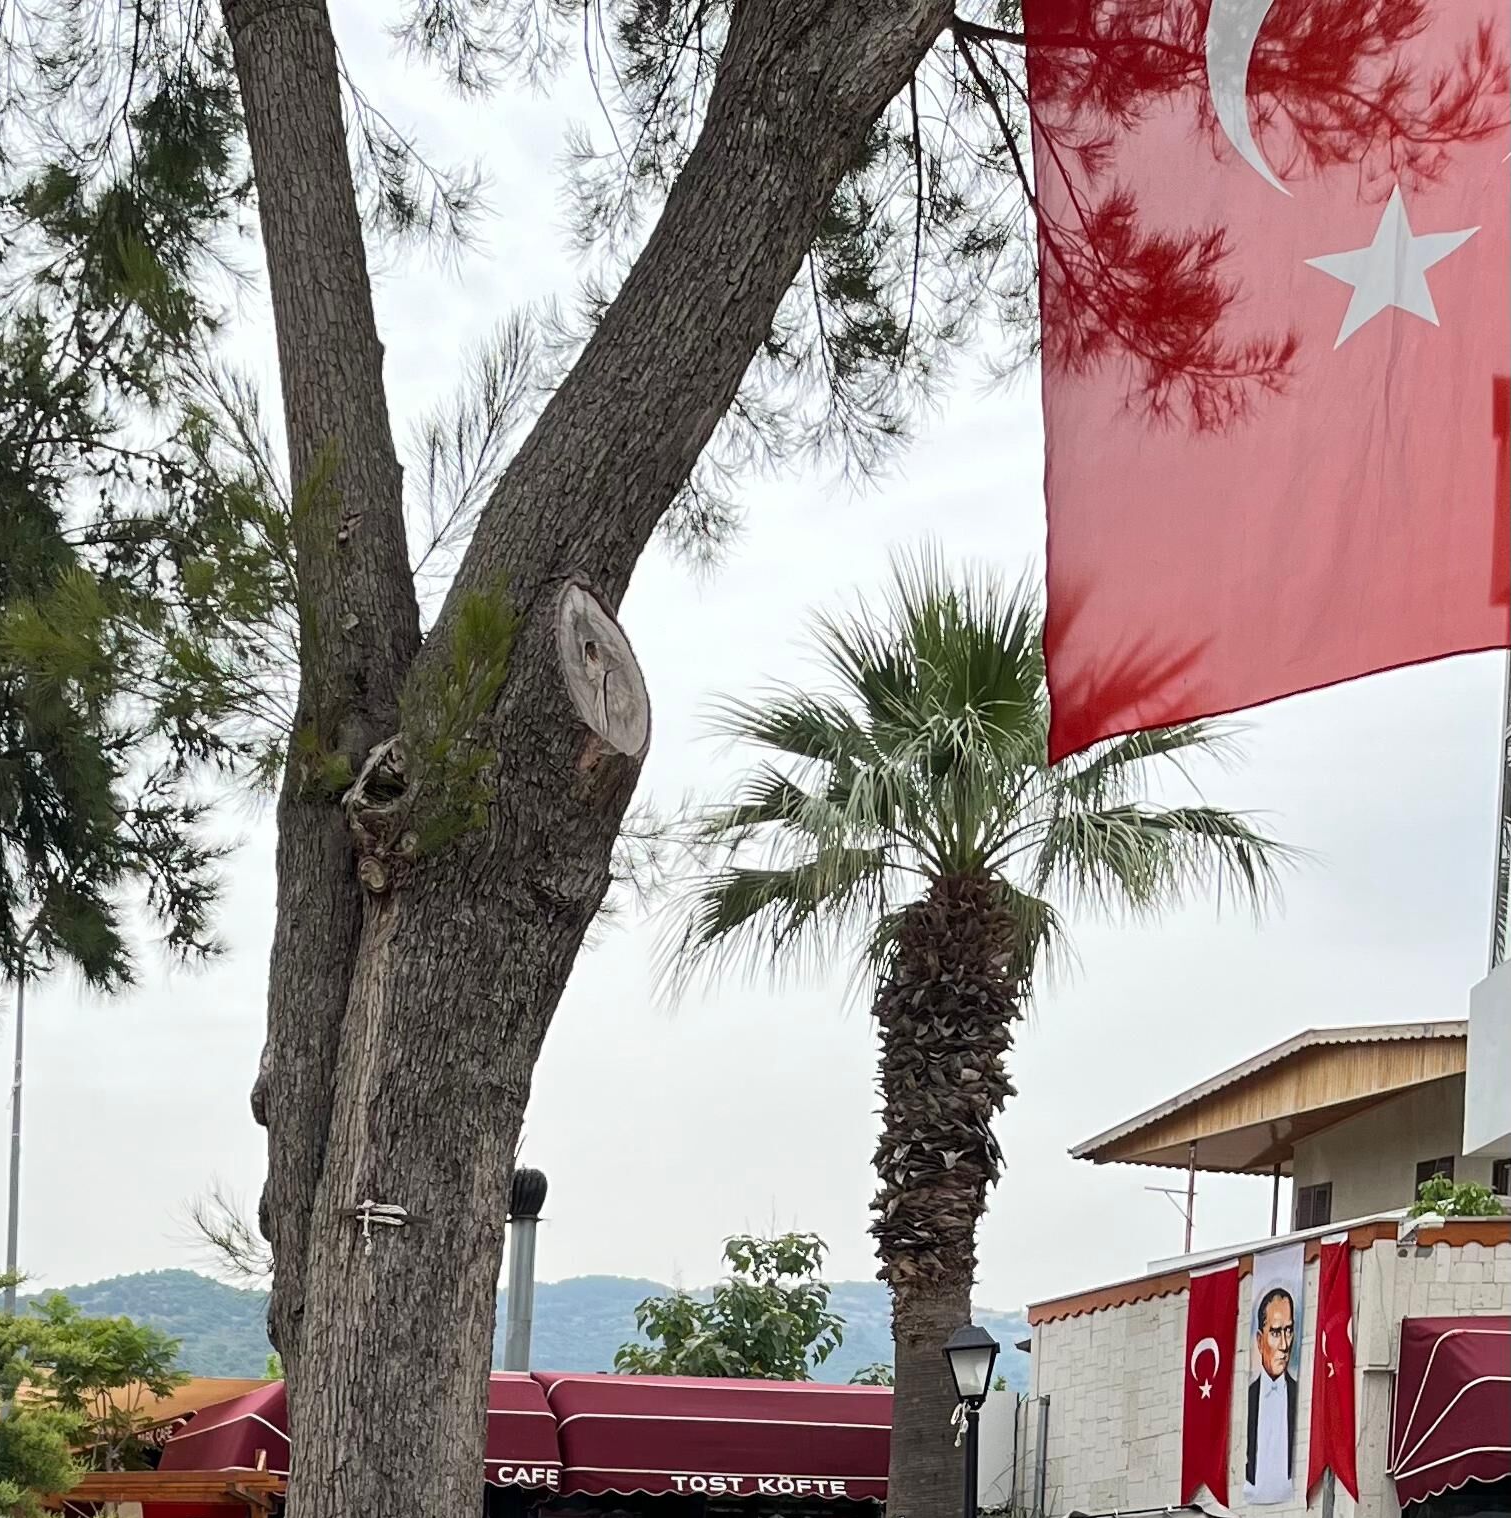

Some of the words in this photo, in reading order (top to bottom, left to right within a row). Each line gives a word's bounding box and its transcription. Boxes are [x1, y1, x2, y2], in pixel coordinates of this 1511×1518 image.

[156, 1425, 174, 1442] CAFE
[498, 1466, 559, 1486] CAFE
[671, 1475, 744, 1493] TOST
[758, 1475, 847, 1496] KÖFTE
